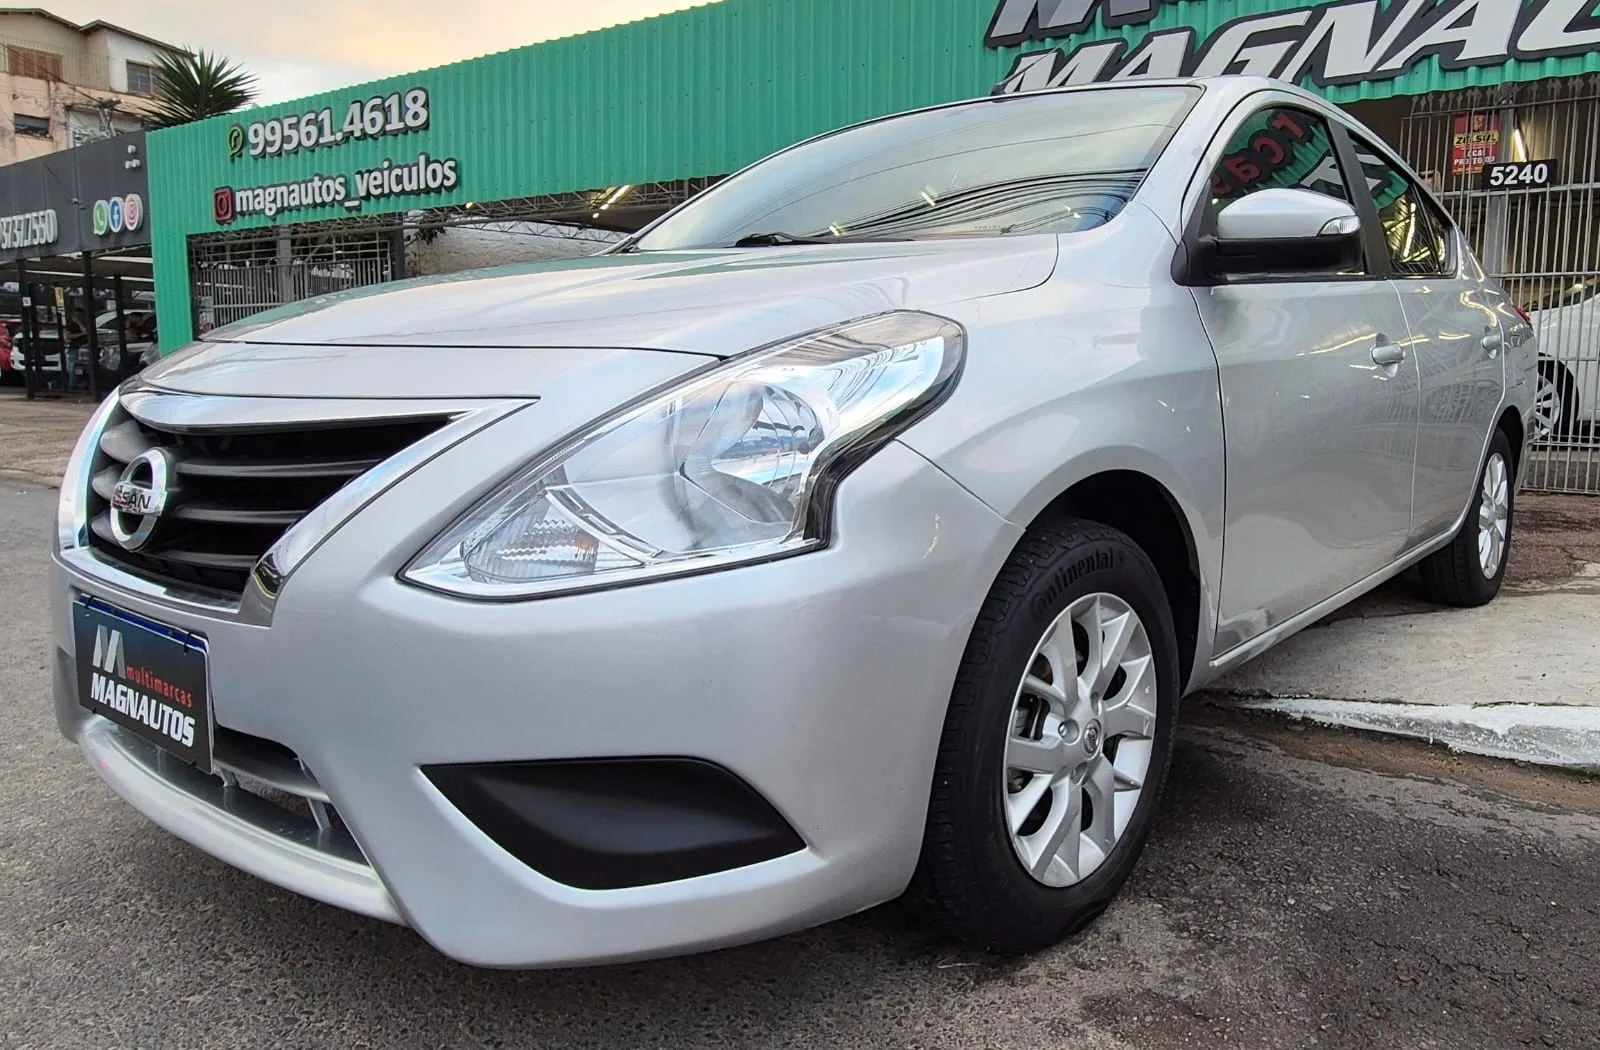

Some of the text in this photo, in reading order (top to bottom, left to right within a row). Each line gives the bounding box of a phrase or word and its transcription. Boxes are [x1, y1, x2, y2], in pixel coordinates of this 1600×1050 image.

[248, 89, 429, 156] 99561.4618
[236, 154, 457, 216] magnautos_veiculos
[1489, 163, 1548, 186] 5240
[1030, 547, 1115, 622] Continental
[90, 672, 196, 748] MAGNAUTOS
[126, 664, 193, 708] multimarcas
